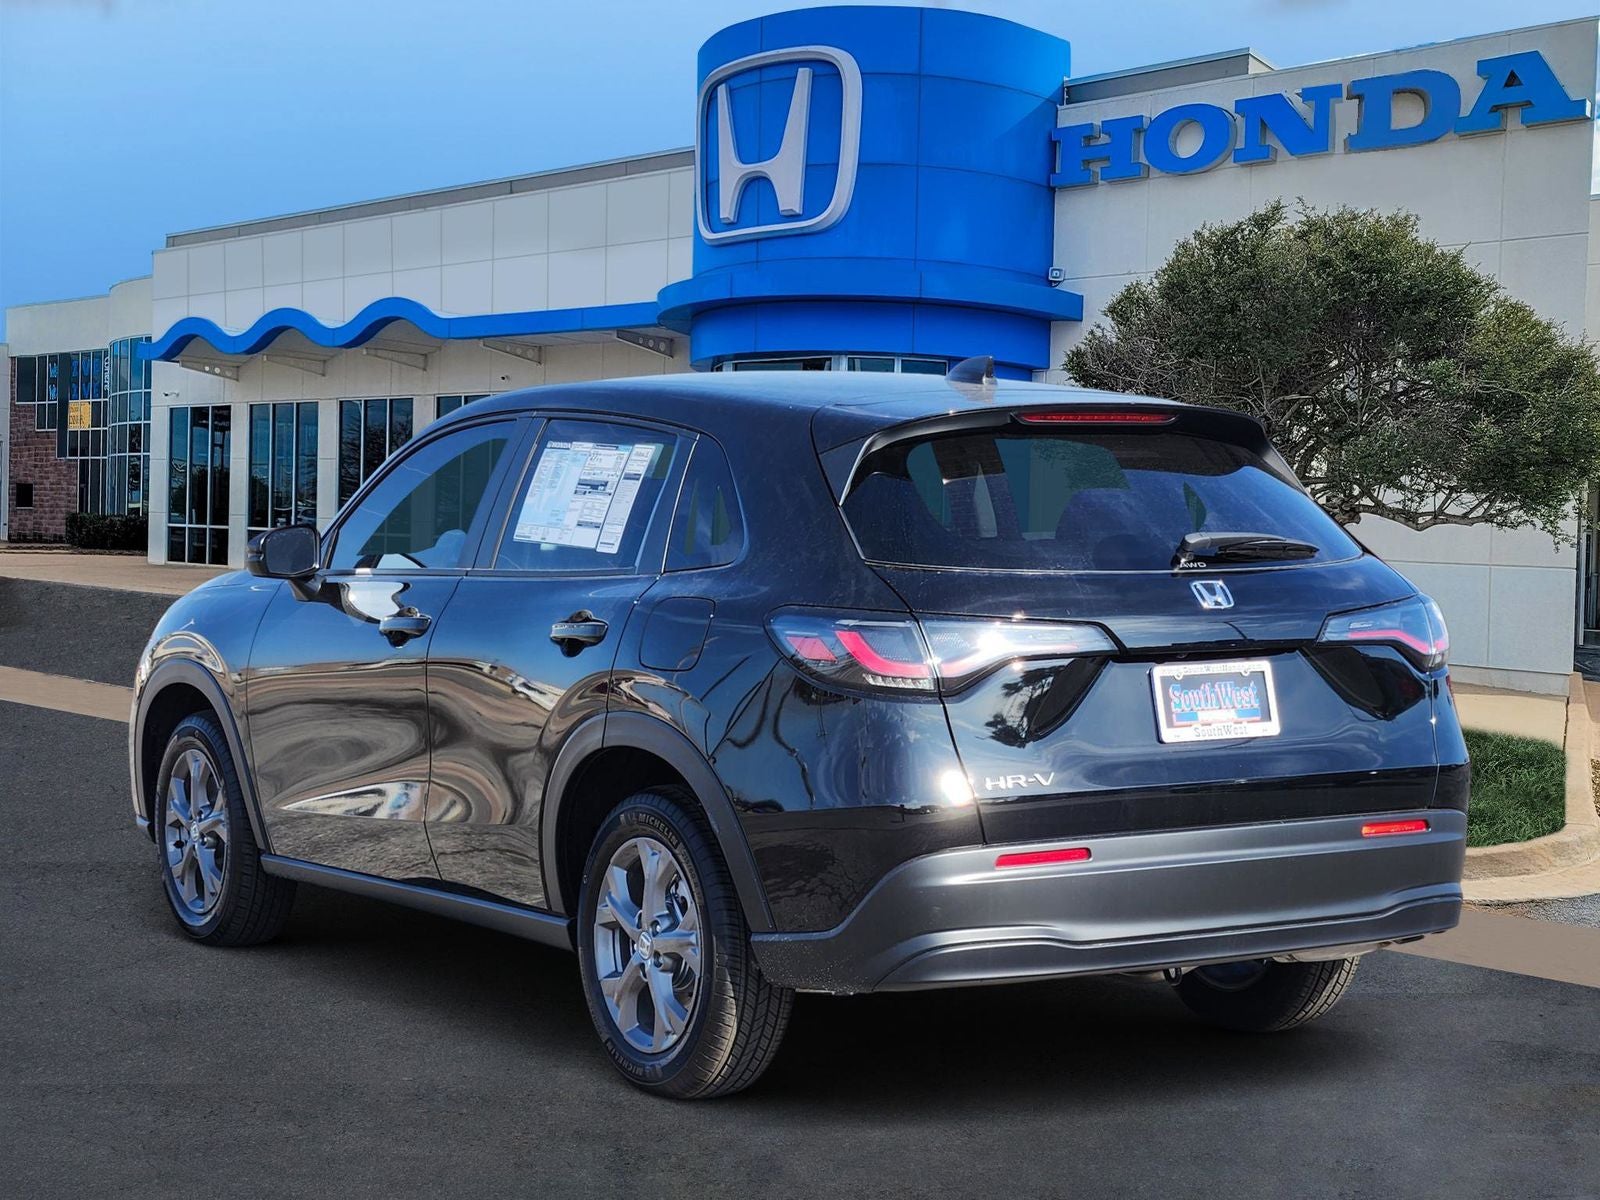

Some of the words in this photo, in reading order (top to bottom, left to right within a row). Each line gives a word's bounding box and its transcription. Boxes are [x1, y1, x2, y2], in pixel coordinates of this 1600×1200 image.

[1050, 50, 1591, 188] HONDA
[1180, 560, 1207, 568] AWD
[1169, 681, 1260, 712] SouthWest
[1193, 724, 1248, 738] SouthWest
[985, 772, 1055, 791] HR-V
[639, 812, 679, 847] MICHELIN
